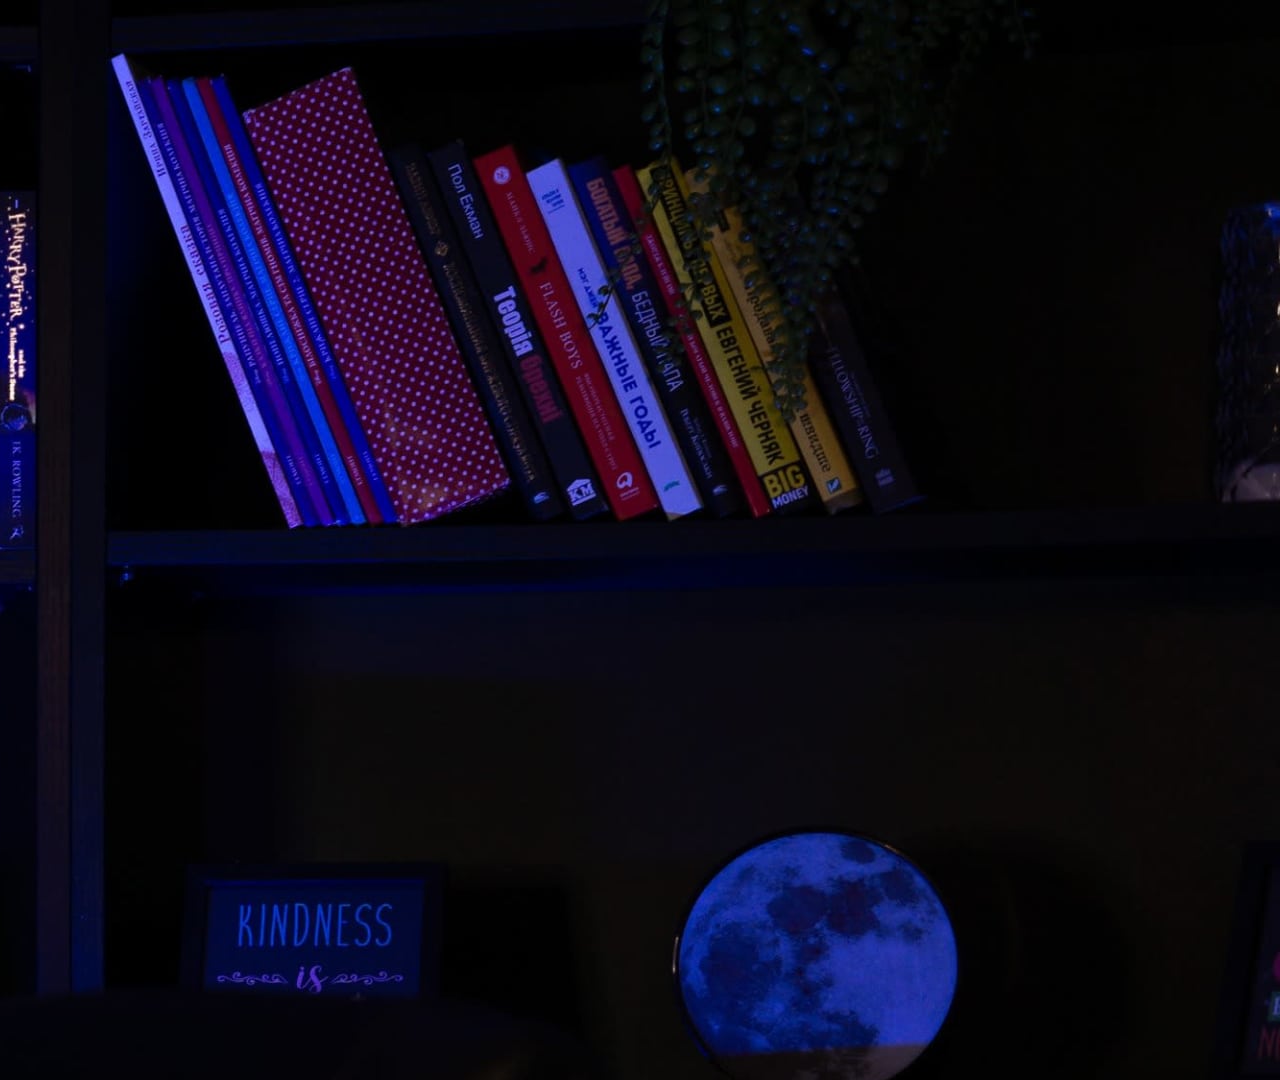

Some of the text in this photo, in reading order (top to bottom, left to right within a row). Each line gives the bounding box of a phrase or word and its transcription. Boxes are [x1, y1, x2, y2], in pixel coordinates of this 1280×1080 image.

[146, 142, 168, 177] Ирина
[446, 162, 488, 241] Пол Екман
[584, 175, 628, 247] БОГАТЫЙ
[7, 213, 28, 321] HARRY POTTER
[179, 224, 233, 344] Розовая сказка
[538, 281, 585, 370] FLASH BOYS
[628, 288, 670, 352] БЕДНЫЙ
[489, 285, 565, 424] Теорія брехні
[594, 312, 638, 393] ВАЖНЫЕ
[629, 396, 661, 449] ГОДЫ
[715, 324, 785, 466] ЕВГЕНИЙ ЧЕРНЯК
[799, 413, 832, 473] швидше
[854, 424, 880, 461] RING
[9, 459, 22, 518] ROWLING
[763, 463, 806, 497] BIG
[771, 486, 809, 509] MONEY
[238, 903, 393, 948] KINDNESS
[295, 964, 325, 993] is
